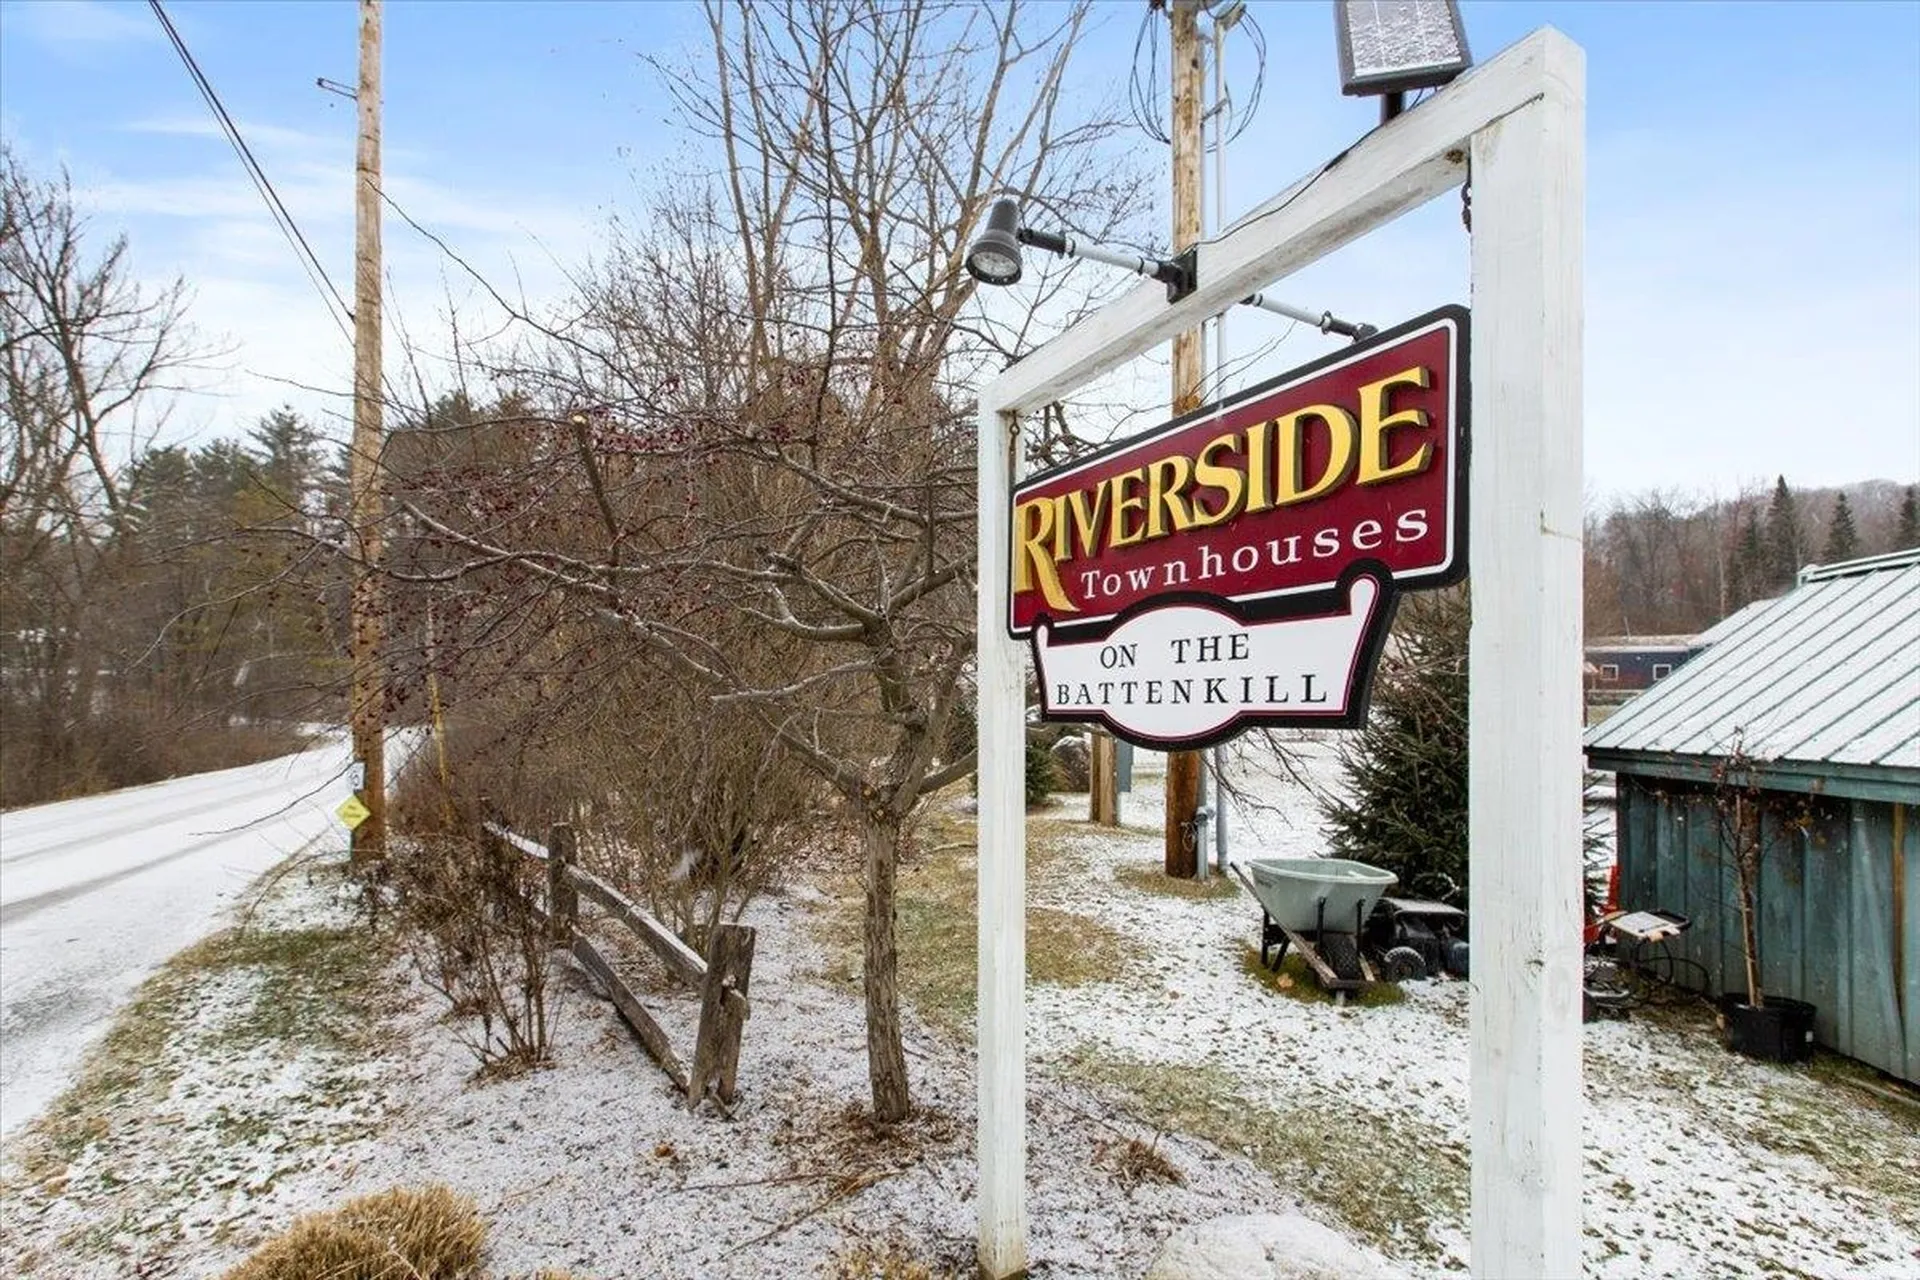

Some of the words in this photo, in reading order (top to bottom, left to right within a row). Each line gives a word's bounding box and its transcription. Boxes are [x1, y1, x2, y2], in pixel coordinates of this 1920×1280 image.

[1013, 366, 1431, 612] RIVERSIDE
[1081, 508, 1429, 599] Townhouses
[1100, 643, 1137, 669] ON
[1171, 633, 1250, 663] THE
[1056, 675, 1328, 706] BATTENKILL
